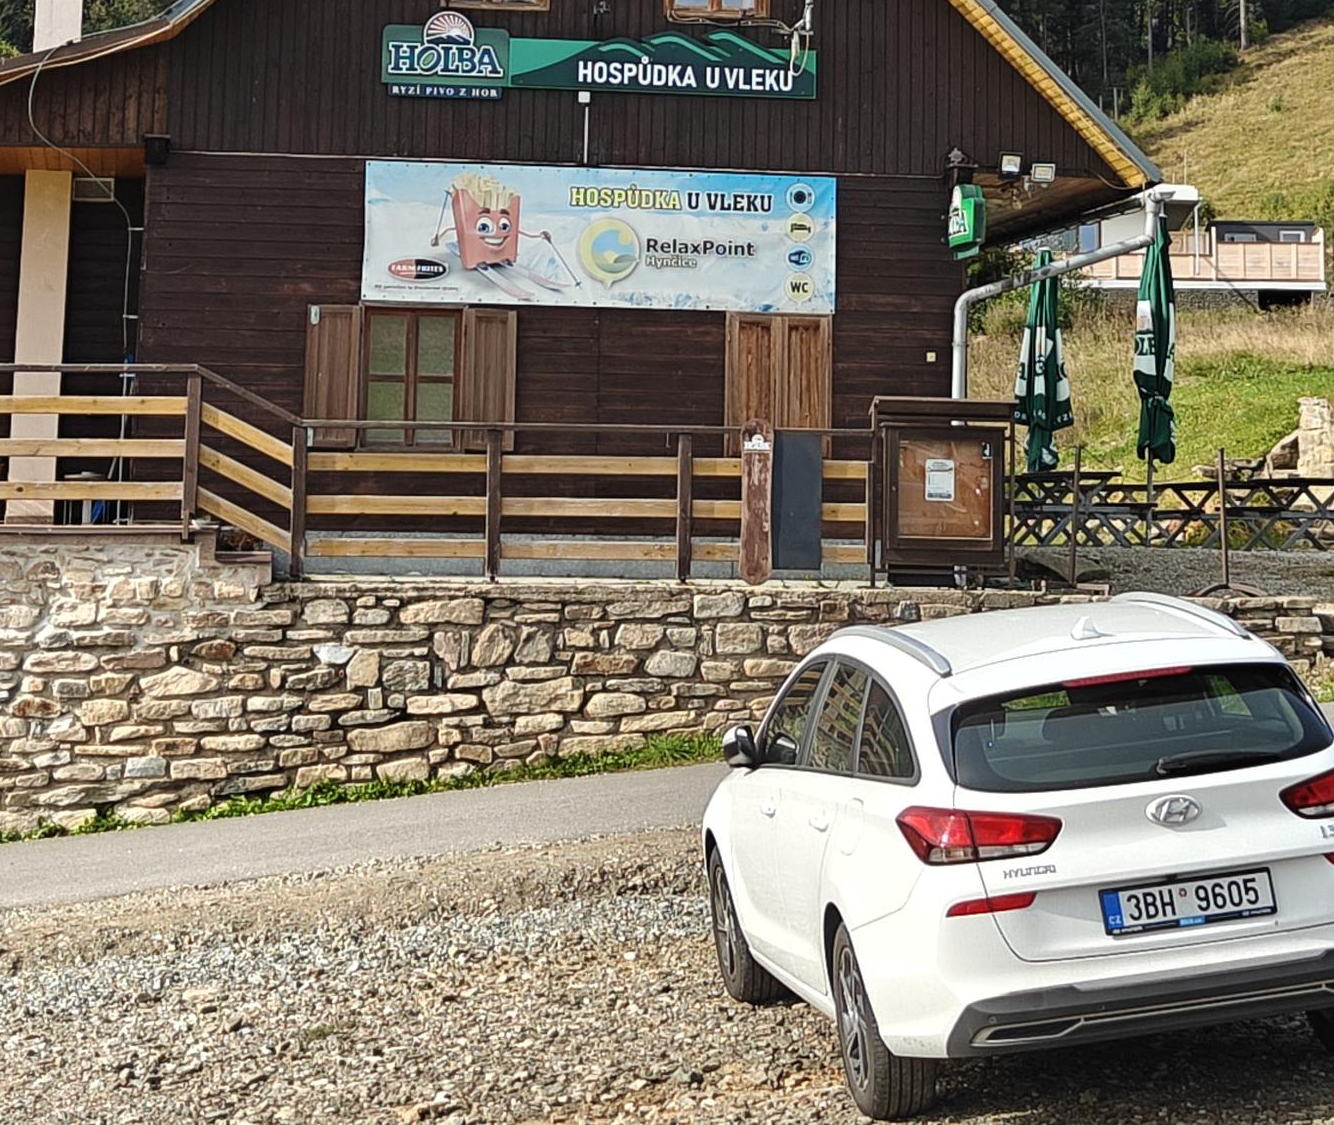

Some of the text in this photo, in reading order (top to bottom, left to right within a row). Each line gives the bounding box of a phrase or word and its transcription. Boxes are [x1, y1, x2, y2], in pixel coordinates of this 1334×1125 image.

[388, 42, 503, 76] HOLBA
[578, 55, 793, 92] HOSPŮDKA U VLEKU
[392, 84, 498, 97] RYZÍ PIVO Z HOR
[570, 184, 772, 212] HOSPŮDKA U VLEKU
[646, 238, 755, 257] RelaxPoint
[645, 255, 698, 269] Hynčice
[790, 281, 809, 294] WC
[1108, 877, 1260, 925] CZ 3BH 9605
